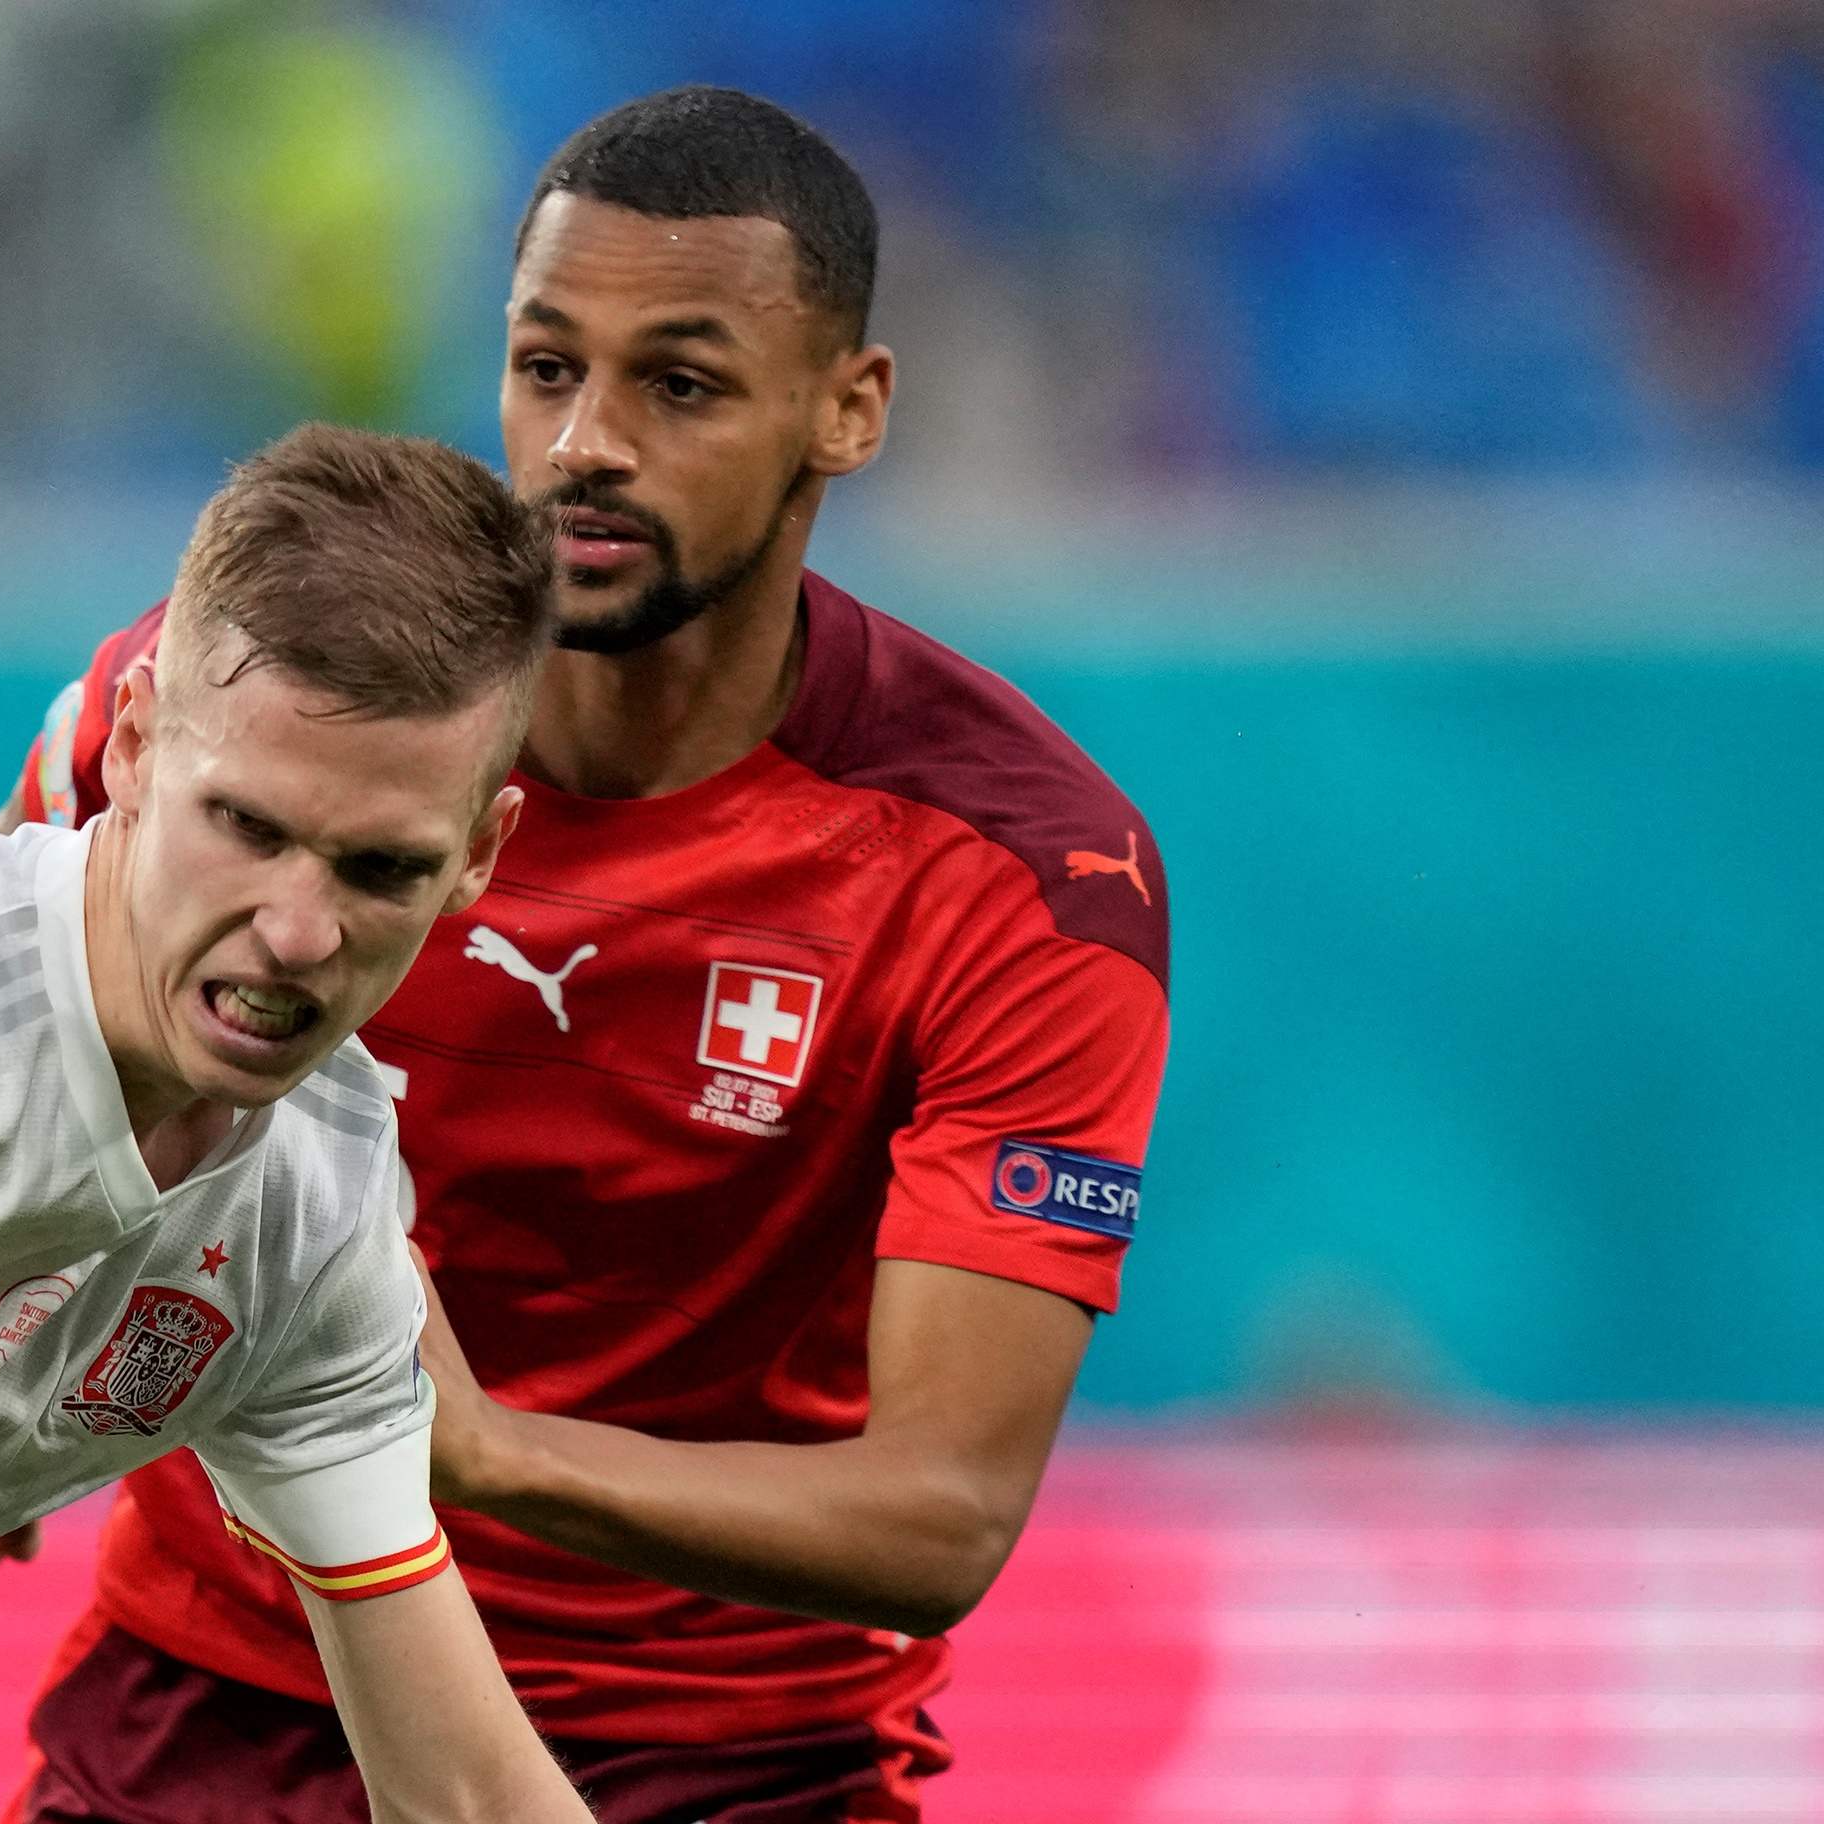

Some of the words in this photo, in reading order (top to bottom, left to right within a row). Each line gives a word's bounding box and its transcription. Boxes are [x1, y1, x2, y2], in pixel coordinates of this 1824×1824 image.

[700, 1083, 736, 1112] SUI
[748, 1096, 783, 1124] ESP
[1053, 1171, 1140, 1221] RESP
